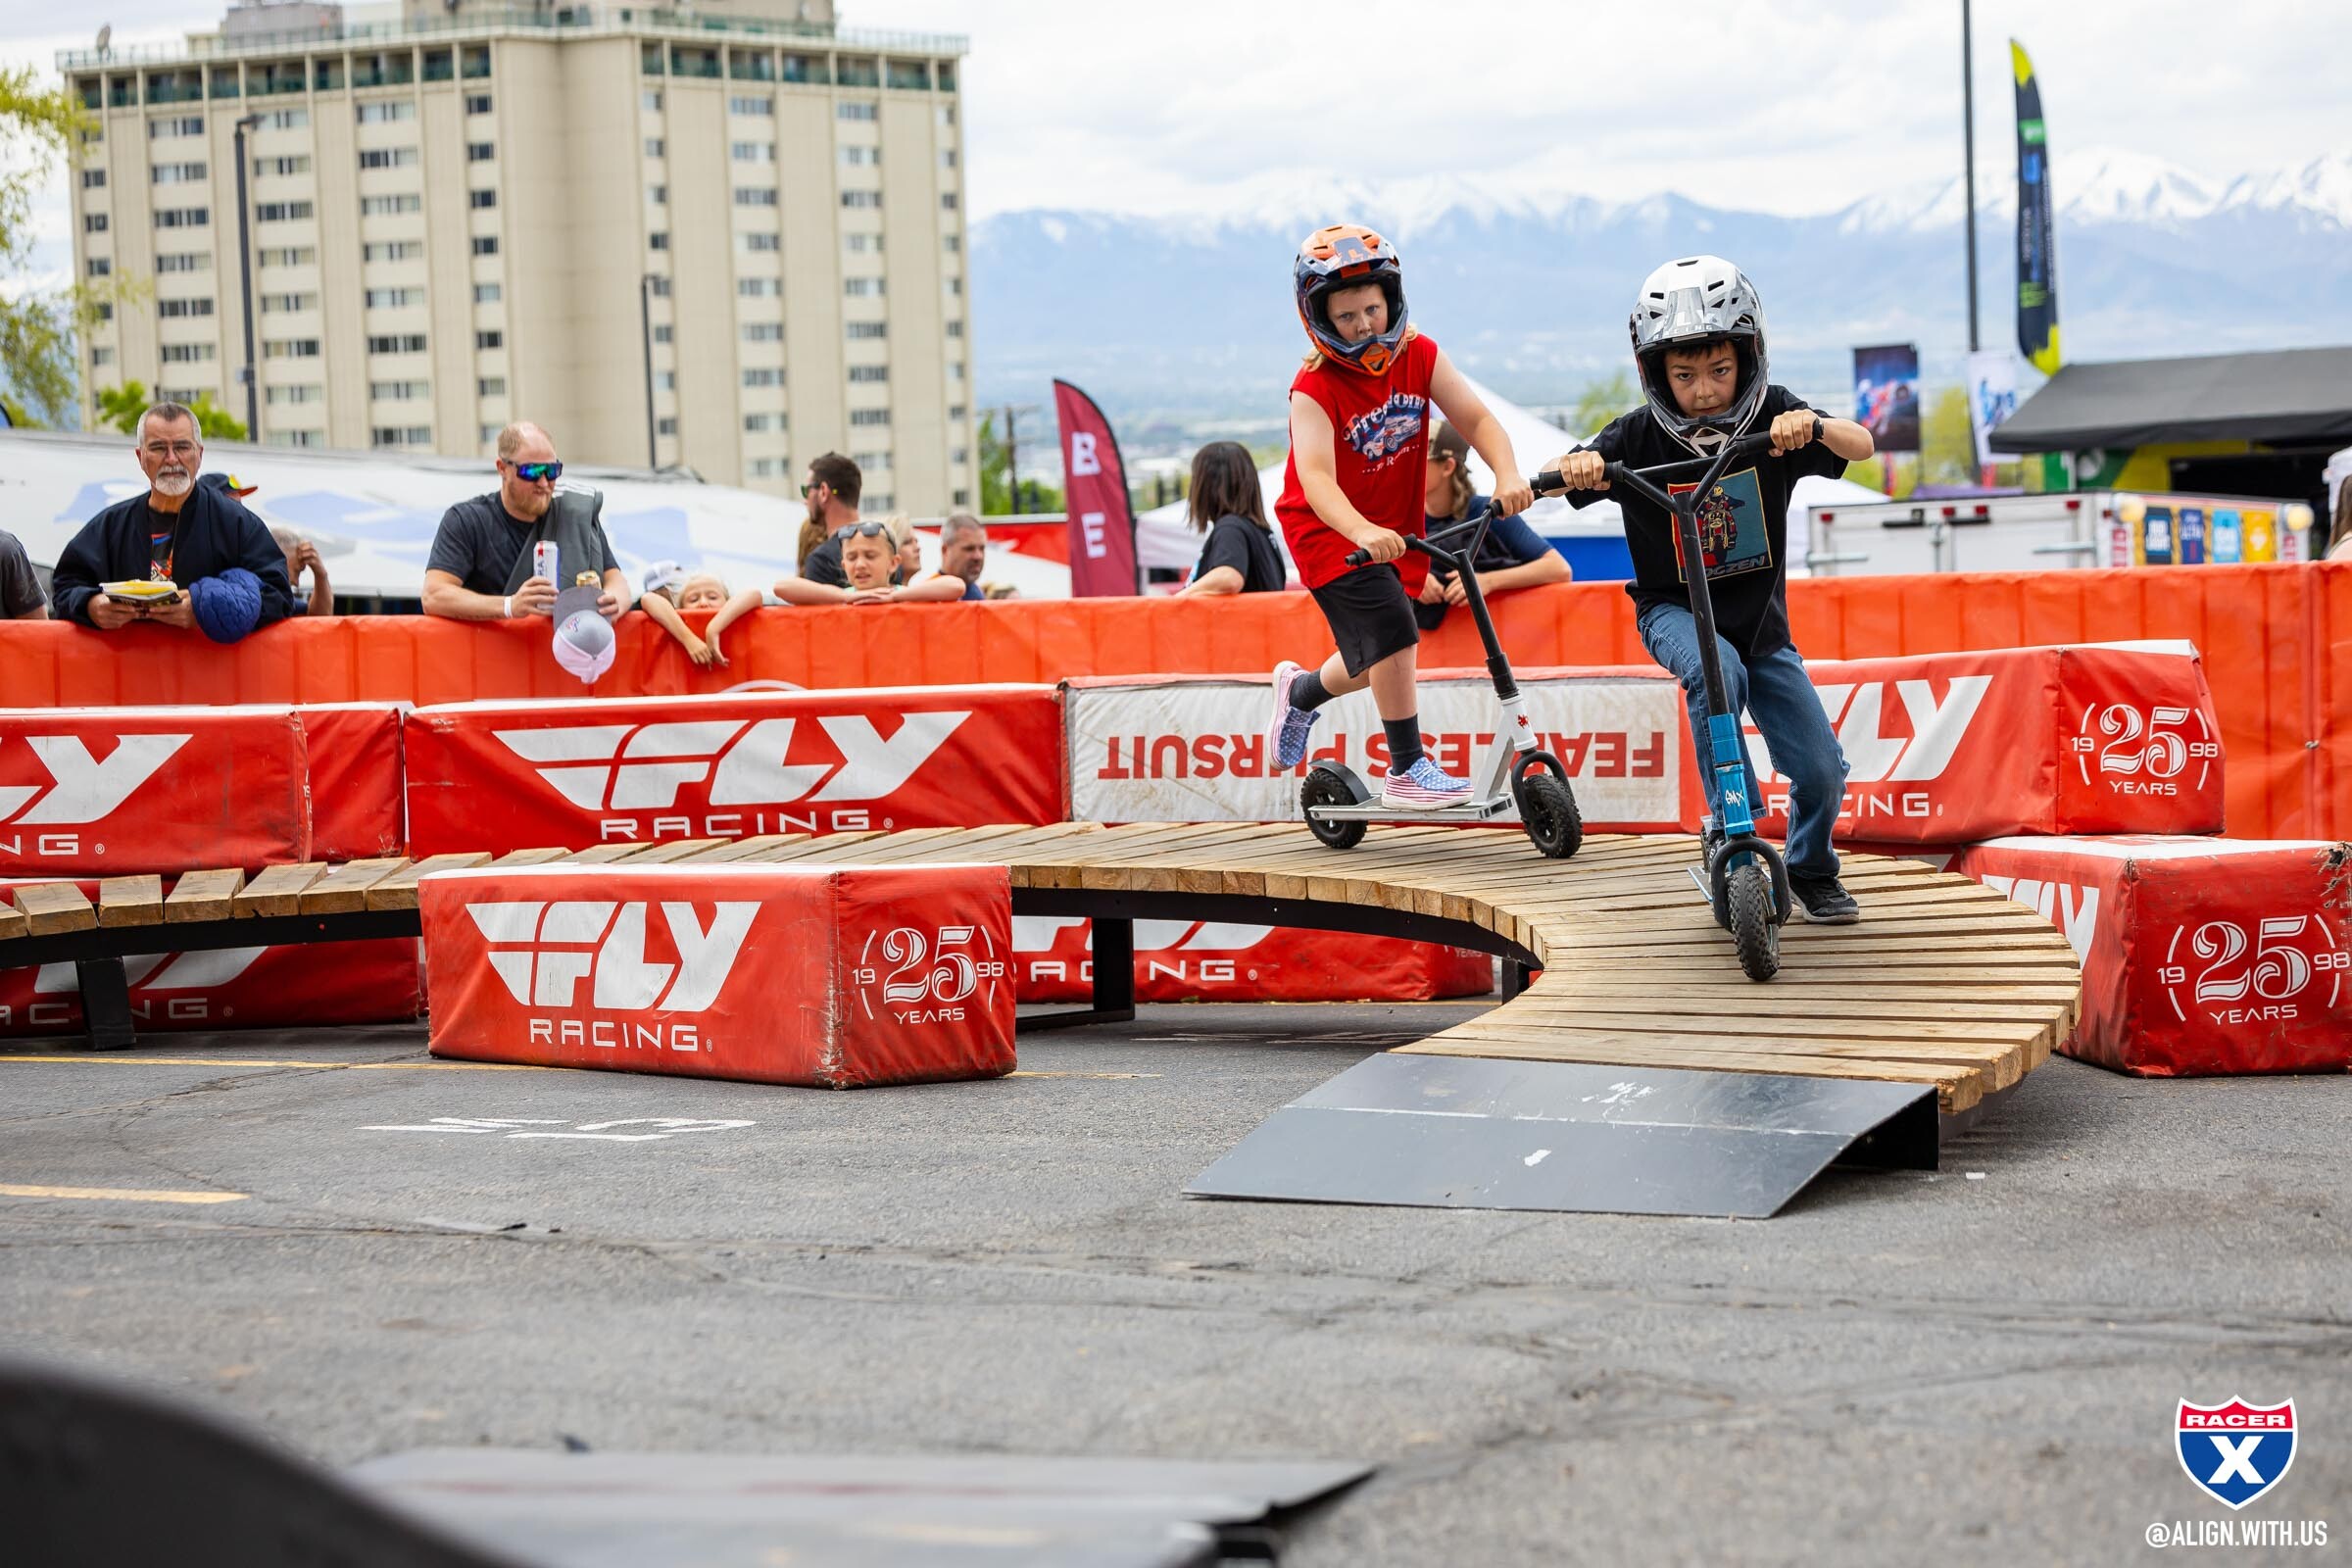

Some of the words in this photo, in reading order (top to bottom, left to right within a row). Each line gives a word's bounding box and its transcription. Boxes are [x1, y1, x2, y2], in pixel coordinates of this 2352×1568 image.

[491, 710, 973, 810] FLY
[2071, 737, 2094, 752] 19
[2099, 704, 2191, 777] 25
[2189, 742, 2219, 758] 98
[1767, 792, 1930, 817] RCING
[2109, 780, 2178, 796] YEARS
[466, 902, 762, 1012] FLY
[852, 968, 876, 985] 19
[883, 925, 977, 1004] 25
[976, 961, 1004, 977] 98
[2156, 966, 2185, 984] 19
[2192, 915, 2310, 1004] 25
[2313, 952, 2350, 971] 98
[894, 1007, 965, 1024] YEARS
[2209, 1004, 2298, 1025] YEARS
